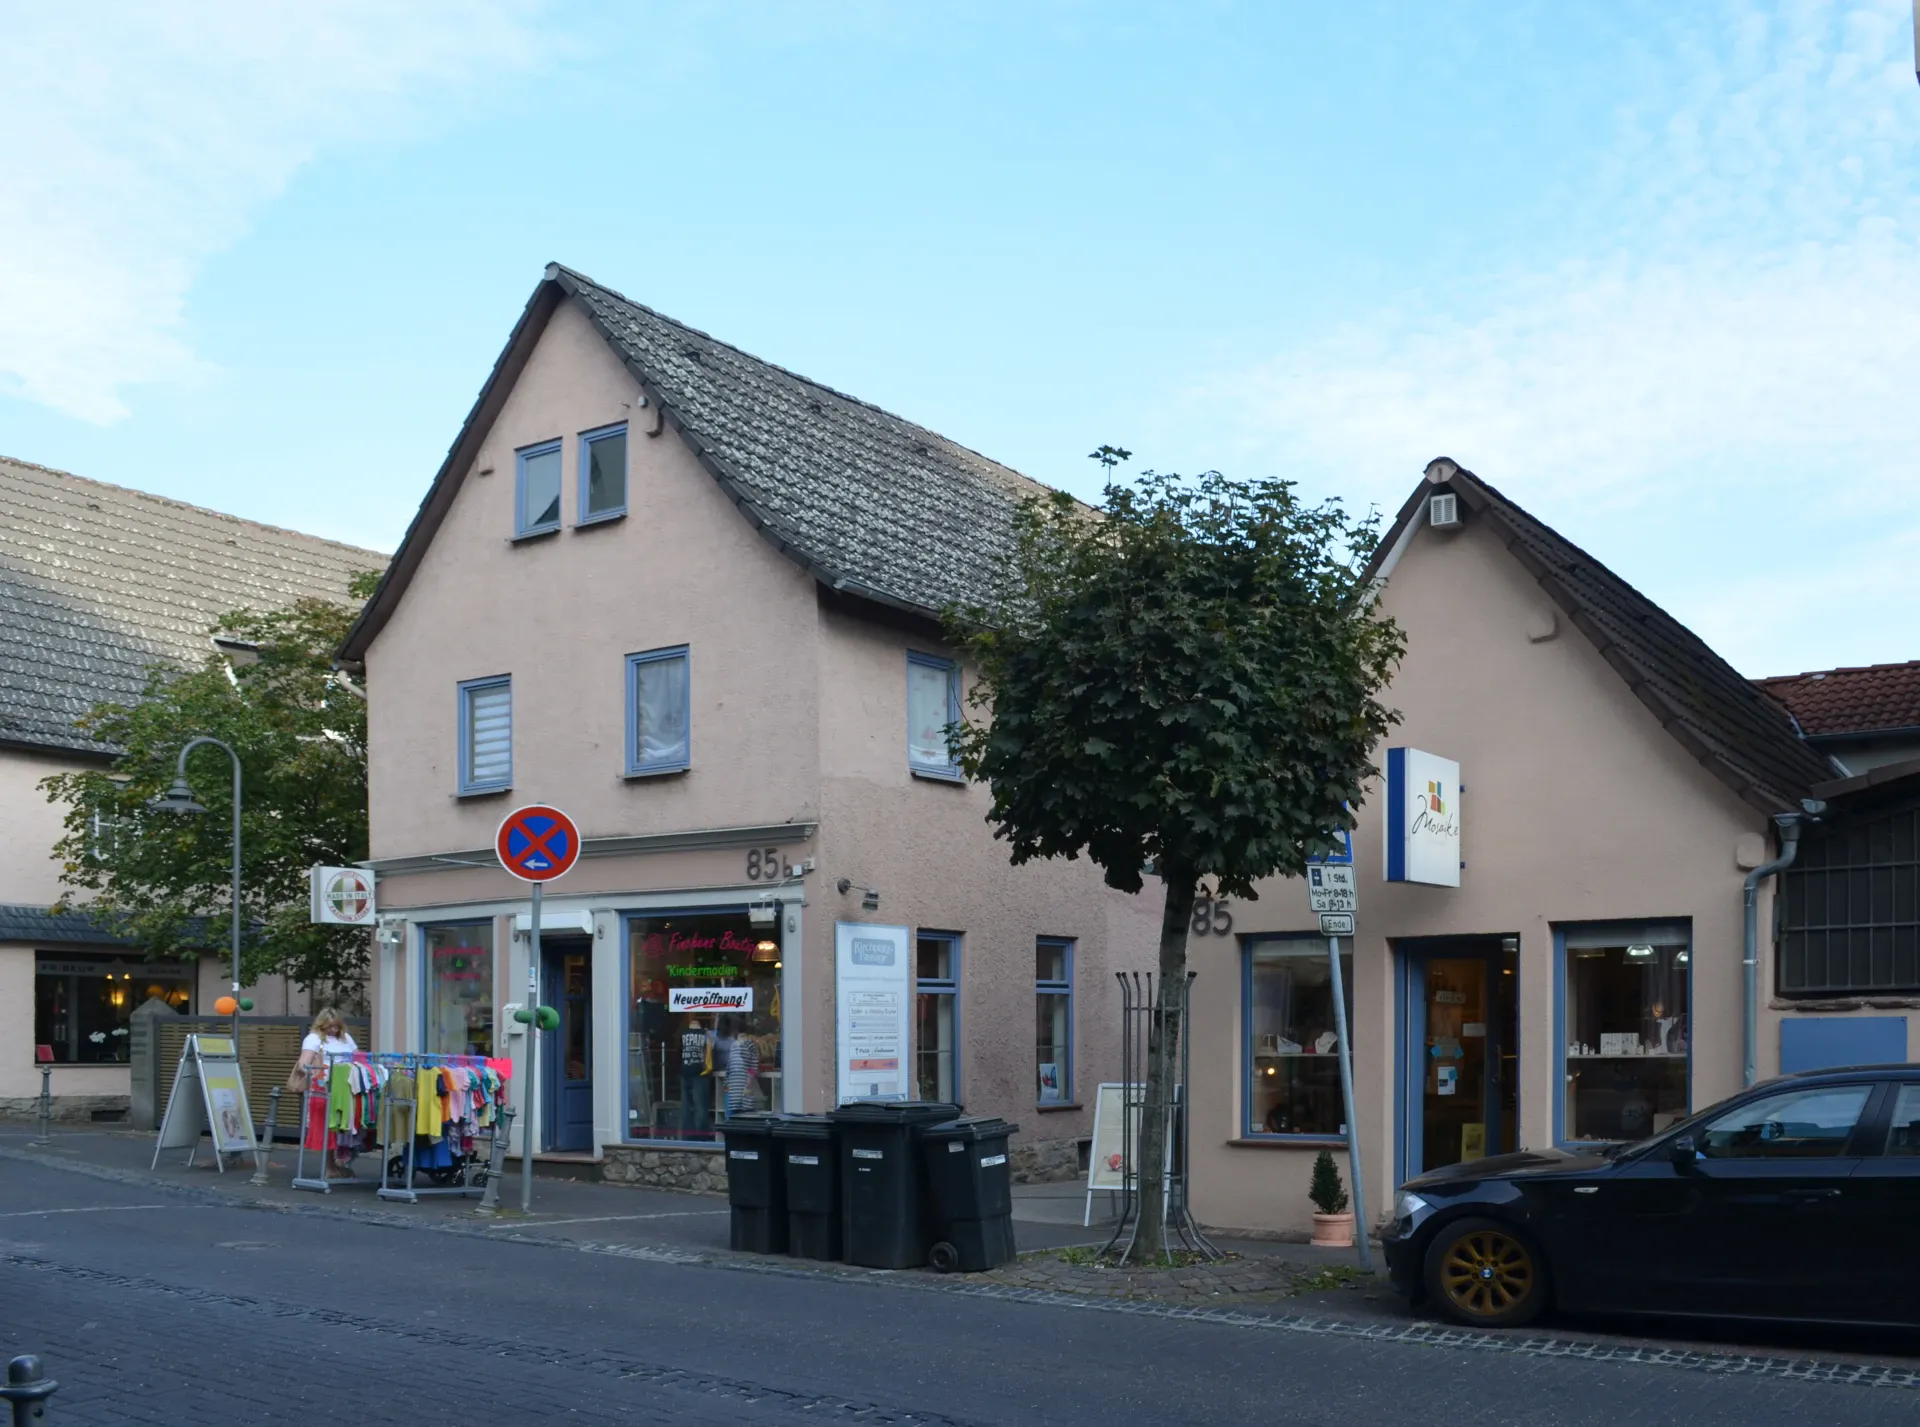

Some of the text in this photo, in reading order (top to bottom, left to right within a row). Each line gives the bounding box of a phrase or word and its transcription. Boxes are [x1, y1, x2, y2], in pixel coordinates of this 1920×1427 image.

[1327, 873, 1349, 883] 1 Std.
[355, 891, 372, 899] ITALY
[1311, 888, 1333, 898] Mo-Fr
[1348, 889, 1354, 898] h
[1316, 899, 1326, 909] Sa
[1346, 900, 1352, 909] h
[1191, 897, 1233, 937] 85
[1327, 919, 1346, 929] Ende
[669, 964, 738, 977] Kindermoden
[673, 991, 749, 1008] Neueröffnung!
